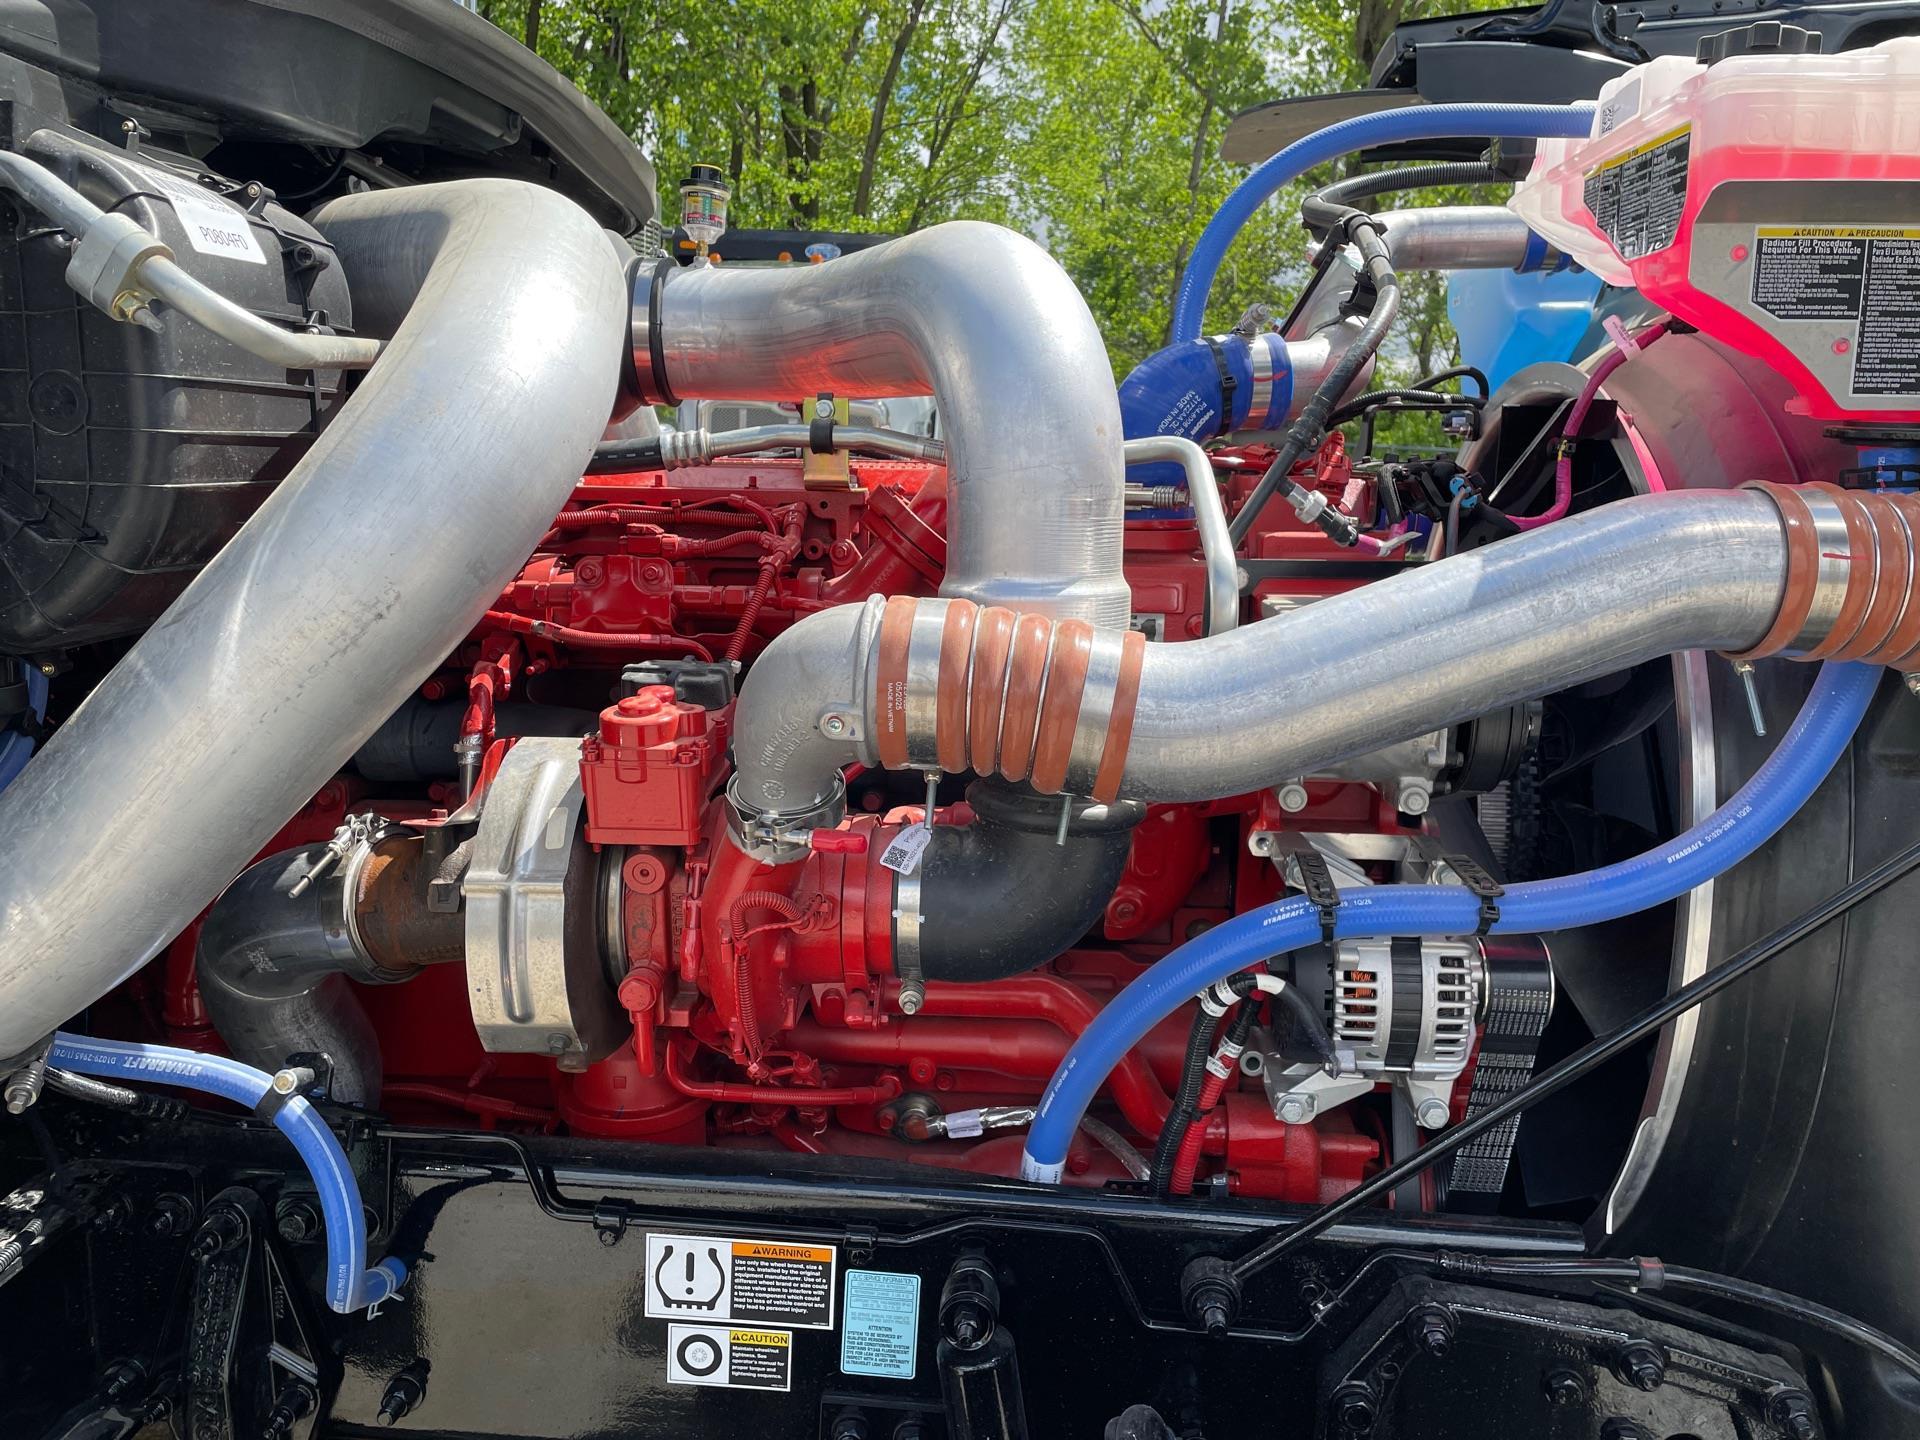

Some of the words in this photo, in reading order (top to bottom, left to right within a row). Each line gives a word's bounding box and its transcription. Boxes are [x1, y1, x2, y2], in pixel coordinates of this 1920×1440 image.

[1801, 229, 1835, 237] CAUTION
[1856, 229, 1905, 237] PRECAUCION
[1762, 239, 1796, 247] Radiator
[1798, 239, 1811, 247] Fill
[1813, 239, 1853, 248] Procedure
[1873, 240, 1909, 248] Procedimiento
[1762, 246, 1797, 254] Required
[1177, 390, 1196, 409] MADE
[1170, 408, 1179, 416] IN
[1157, 414, 1173, 433] INDIA
[761, 1247, 812, 1258] WARNING
[882, 1276, 913, 1284] INFORMATION
[791, 1306, 809, 1314] injury.
[741, 1333, 787, 1344] CAUTION
